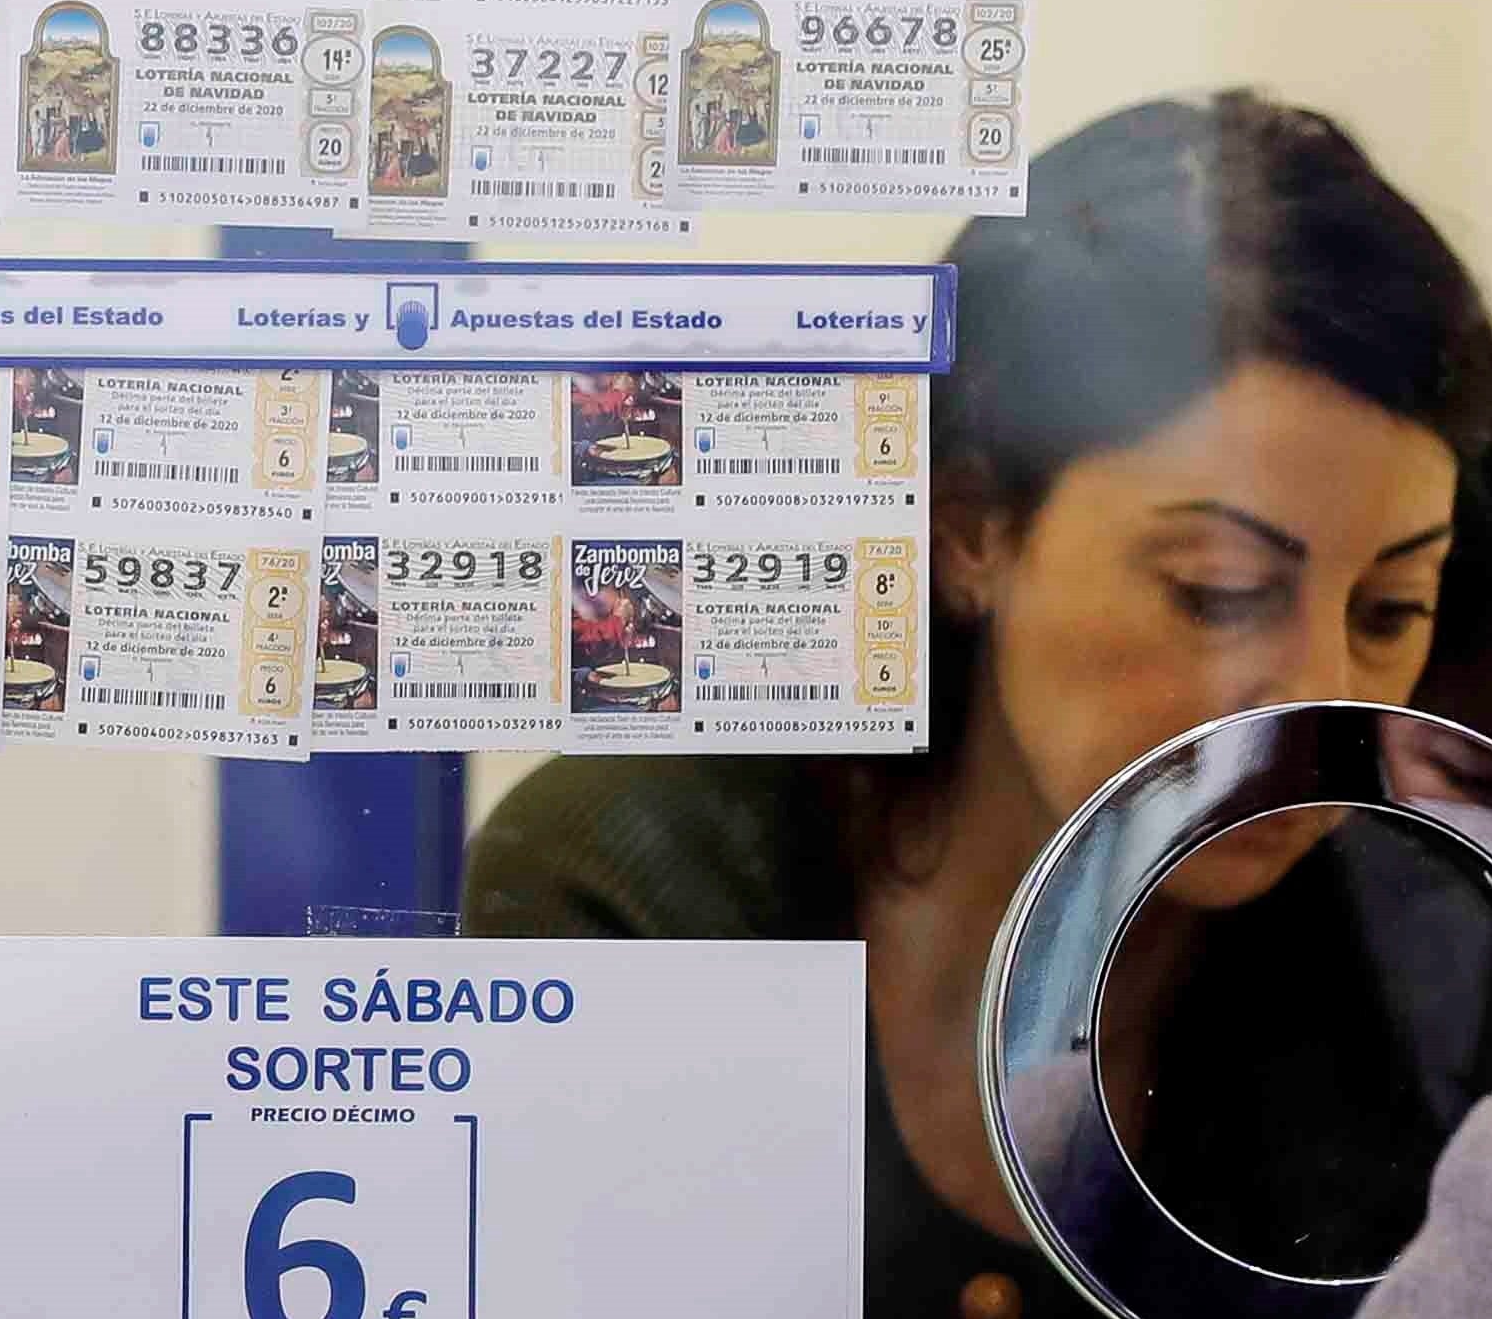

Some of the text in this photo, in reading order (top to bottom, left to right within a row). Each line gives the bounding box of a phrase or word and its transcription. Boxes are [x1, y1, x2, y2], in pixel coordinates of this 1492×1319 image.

[237, 307, 723, 333] Loterías y Apuestas del Estado
[386, 549, 545, 582] 32918
[574, 544, 680, 568] Zambomba
[692, 553, 849, 585] 32919
[84, 553, 242, 592] 59837
[140, 968, 574, 1024] ESTE SÁBADO
[226, 1046, 471, 1093] SORTEO
[251, 1104, 416, 1123] PRECIO DÉCIMO
